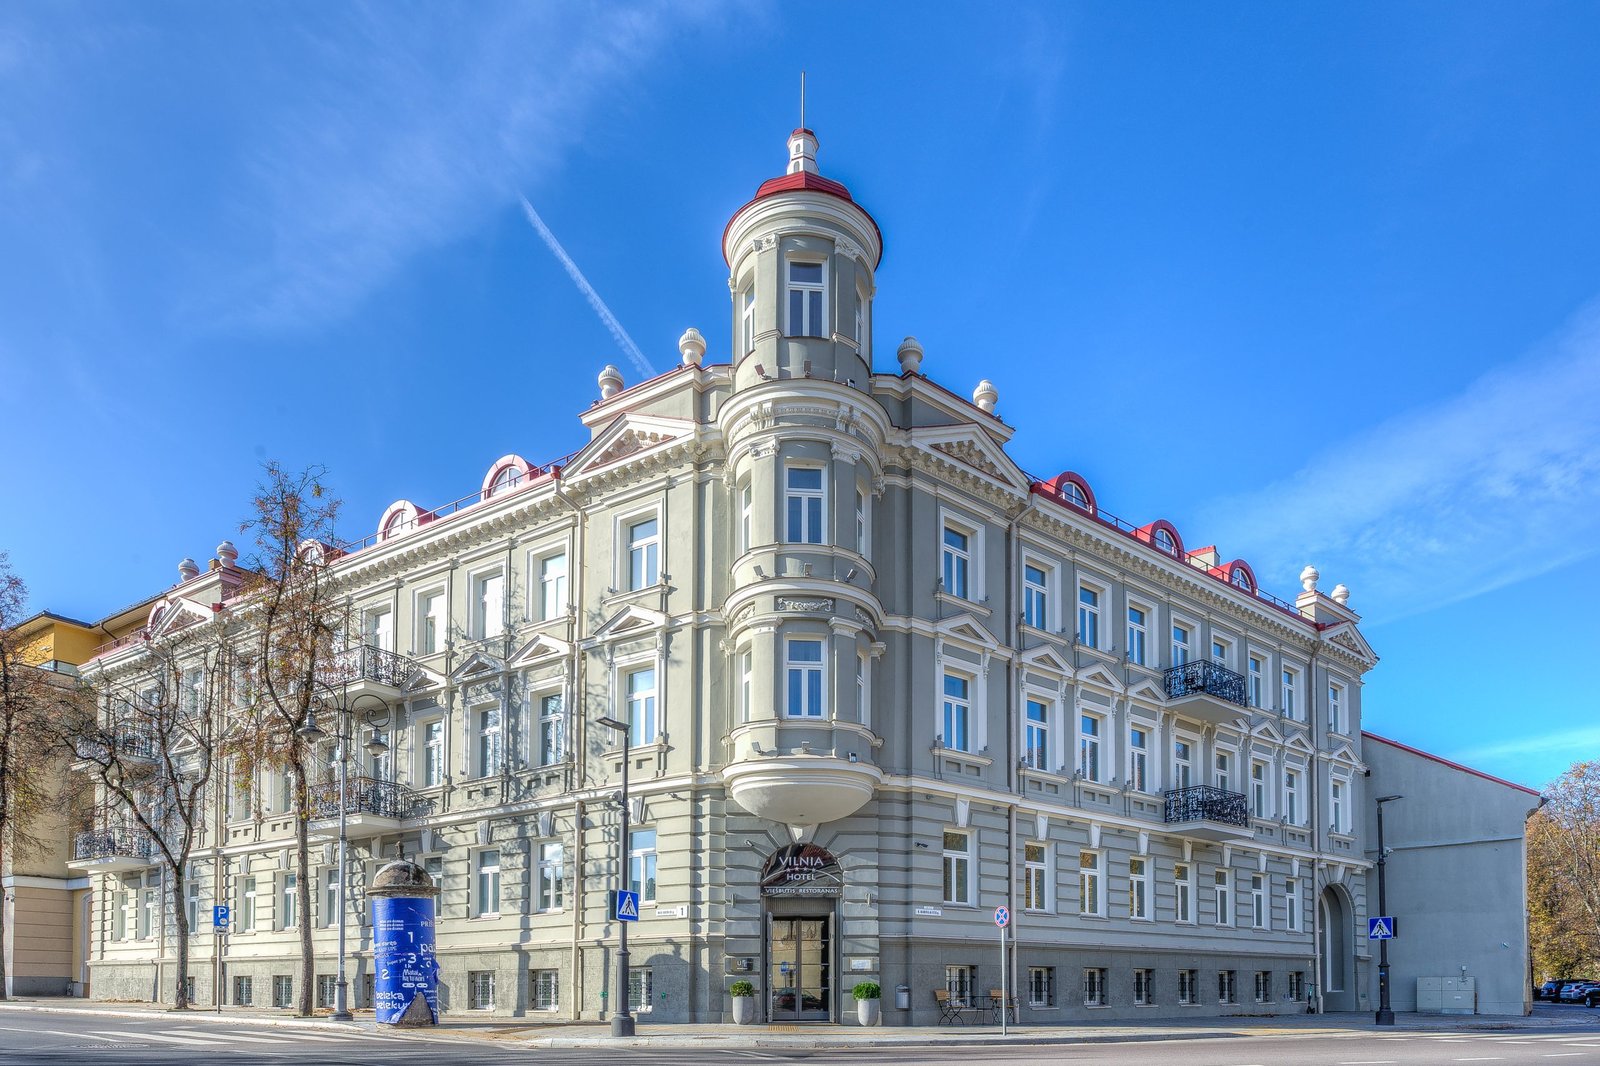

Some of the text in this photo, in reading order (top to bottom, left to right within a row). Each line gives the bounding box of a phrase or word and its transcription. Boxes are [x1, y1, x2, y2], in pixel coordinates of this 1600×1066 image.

[779, 856, 824, 866] VILNIA
[786, 873, 816, 881] HOTEL
[218, 907, 227, 918] P
[680, 907, 684, 916] 1
[407, 931, 414, 944] 1
[407, 952, 417, 964] 3
[381, 968, 390, 980] 2
